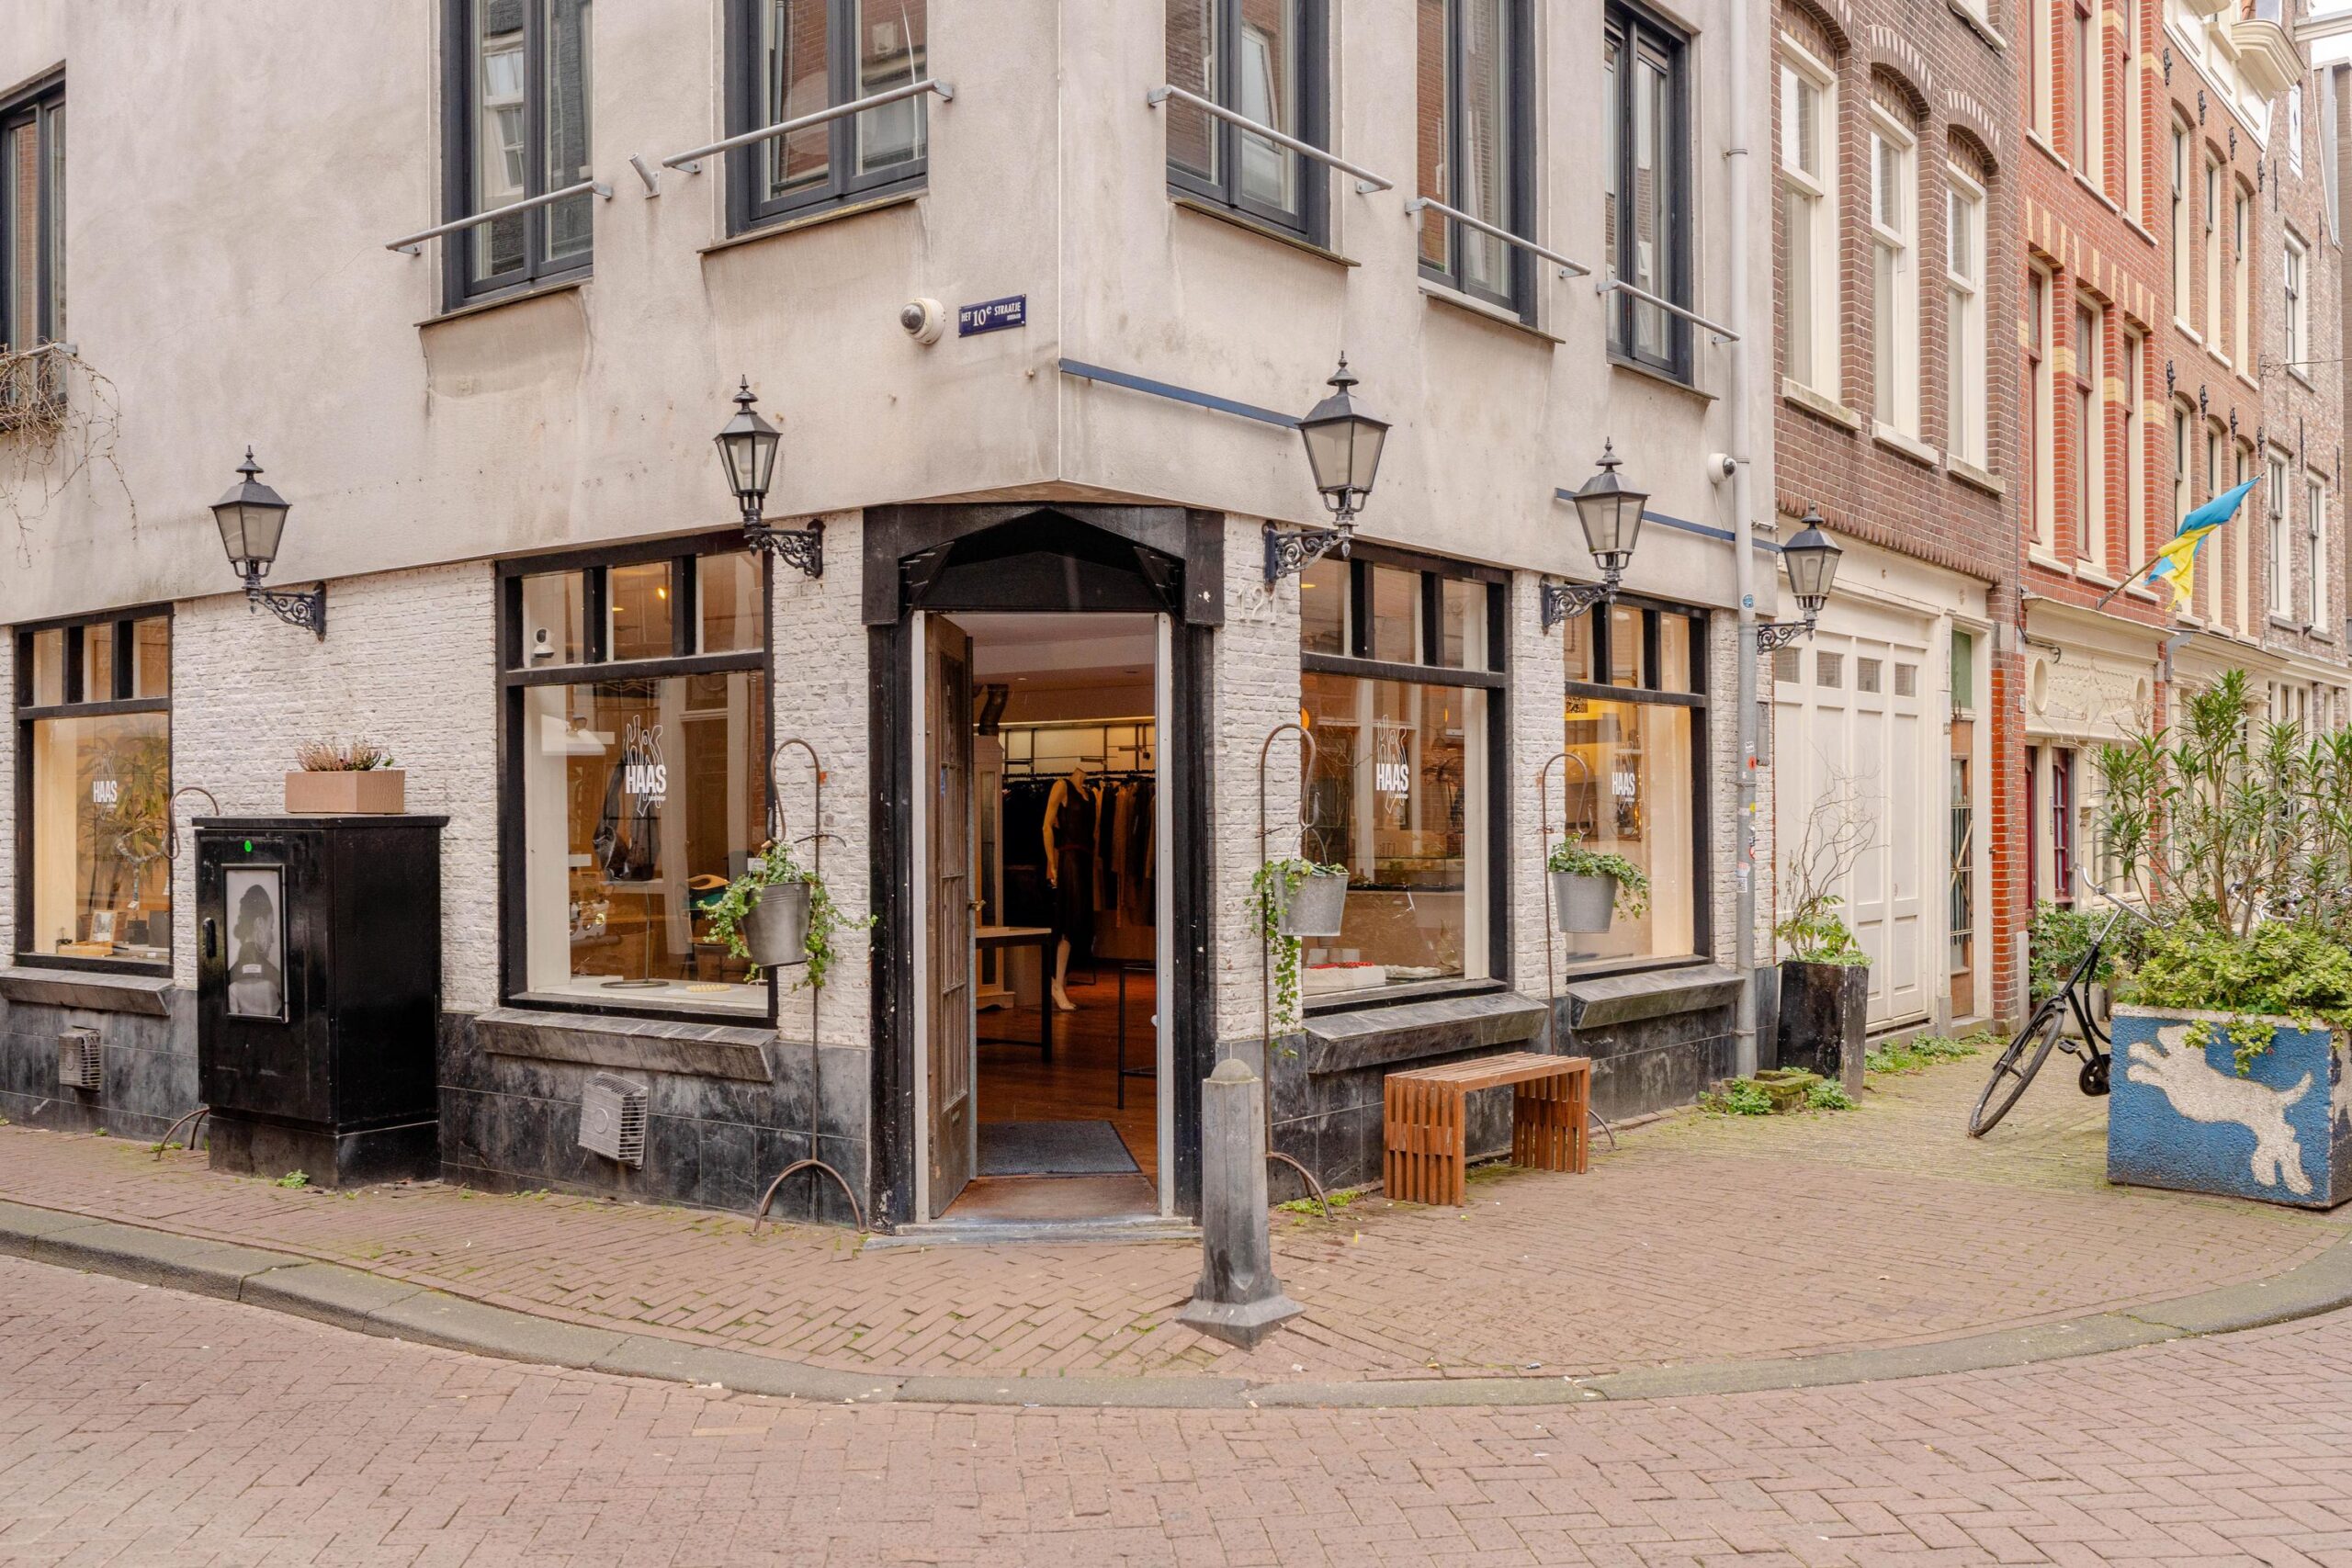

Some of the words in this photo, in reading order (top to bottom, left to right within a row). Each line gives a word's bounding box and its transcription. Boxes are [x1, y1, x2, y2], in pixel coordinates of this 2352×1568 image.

[961, 311, 971, 321] HET
[994, 302, 1021, 316] STRAATJE
[1238, 583, 1276, 624] 121
[626, 764, 667, 794] HAAS
[1376, 763, 1409, 791] HAAS
[1611, 772, 1635, 795] HAAS
[93, 780, 118, 803] HAAS
